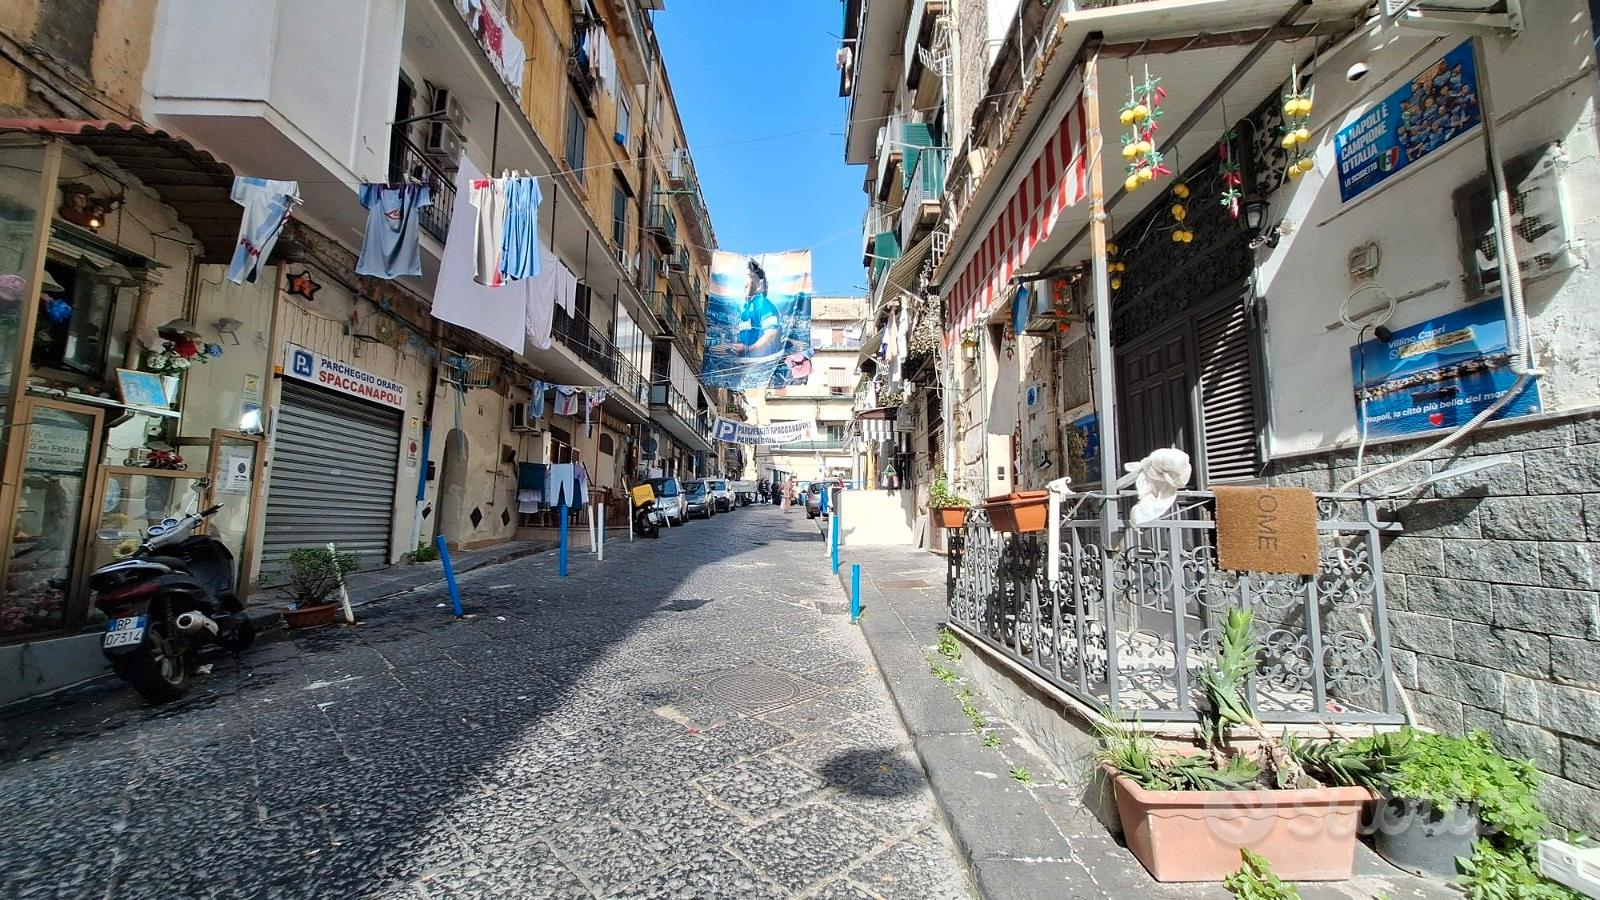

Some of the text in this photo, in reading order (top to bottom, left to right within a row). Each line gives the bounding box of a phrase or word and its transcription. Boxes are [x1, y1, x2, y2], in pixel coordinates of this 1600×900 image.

[1341, 120, 1388, 160] CAMPIONE
[1349, 110, 1381, 141] NAPOLI
[1342, 143, 1378, 175] D'ITALIA
[1417, 323, 1446, 340] Capri
[318, 370, 403, 406] SPACCANAPOLI
[321, 358, 403, 394] PARCHEGGIO ORARIO
[1366, 411, 1392, 423] Napoli,
[1402, 406, 1422, 416] città
[1423, 402, 1438, 414] più
[1440, 398, 1464, 409] bella
[1465, 393, 1482, 403] del
[1484, 389, 1509, 401] mar
[720, 421, 734, 438] P
[1258, 494, 1278, 551] OME
[106, 630, 142, 646] 07314
[118, 618, 132, 631] BP
